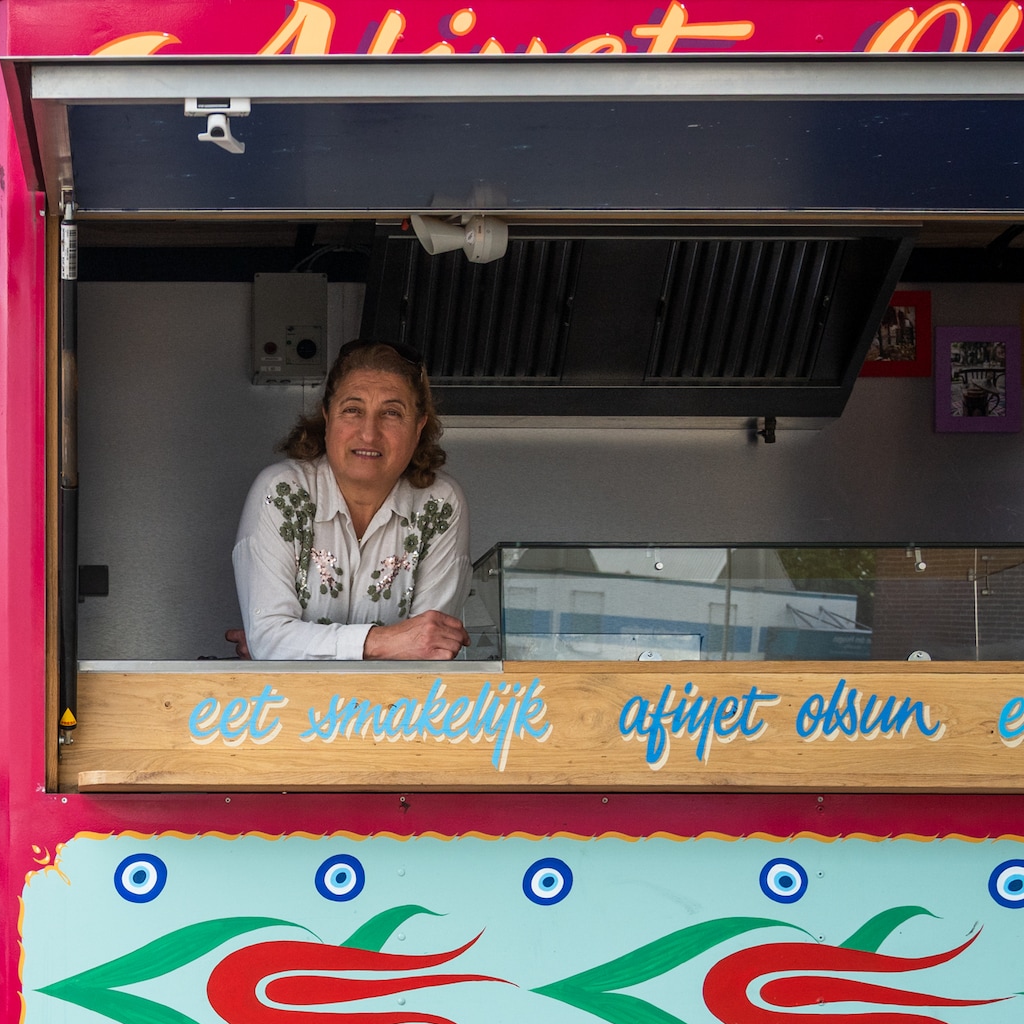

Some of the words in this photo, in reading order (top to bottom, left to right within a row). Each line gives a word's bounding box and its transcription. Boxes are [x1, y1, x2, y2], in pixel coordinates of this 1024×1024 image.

[188, 684, 287, 746] eet
[299, 678, 553, 771] smakelijk
[619, 682, 780, 770] afiyet
[796, 679, 945, 742] olsun
